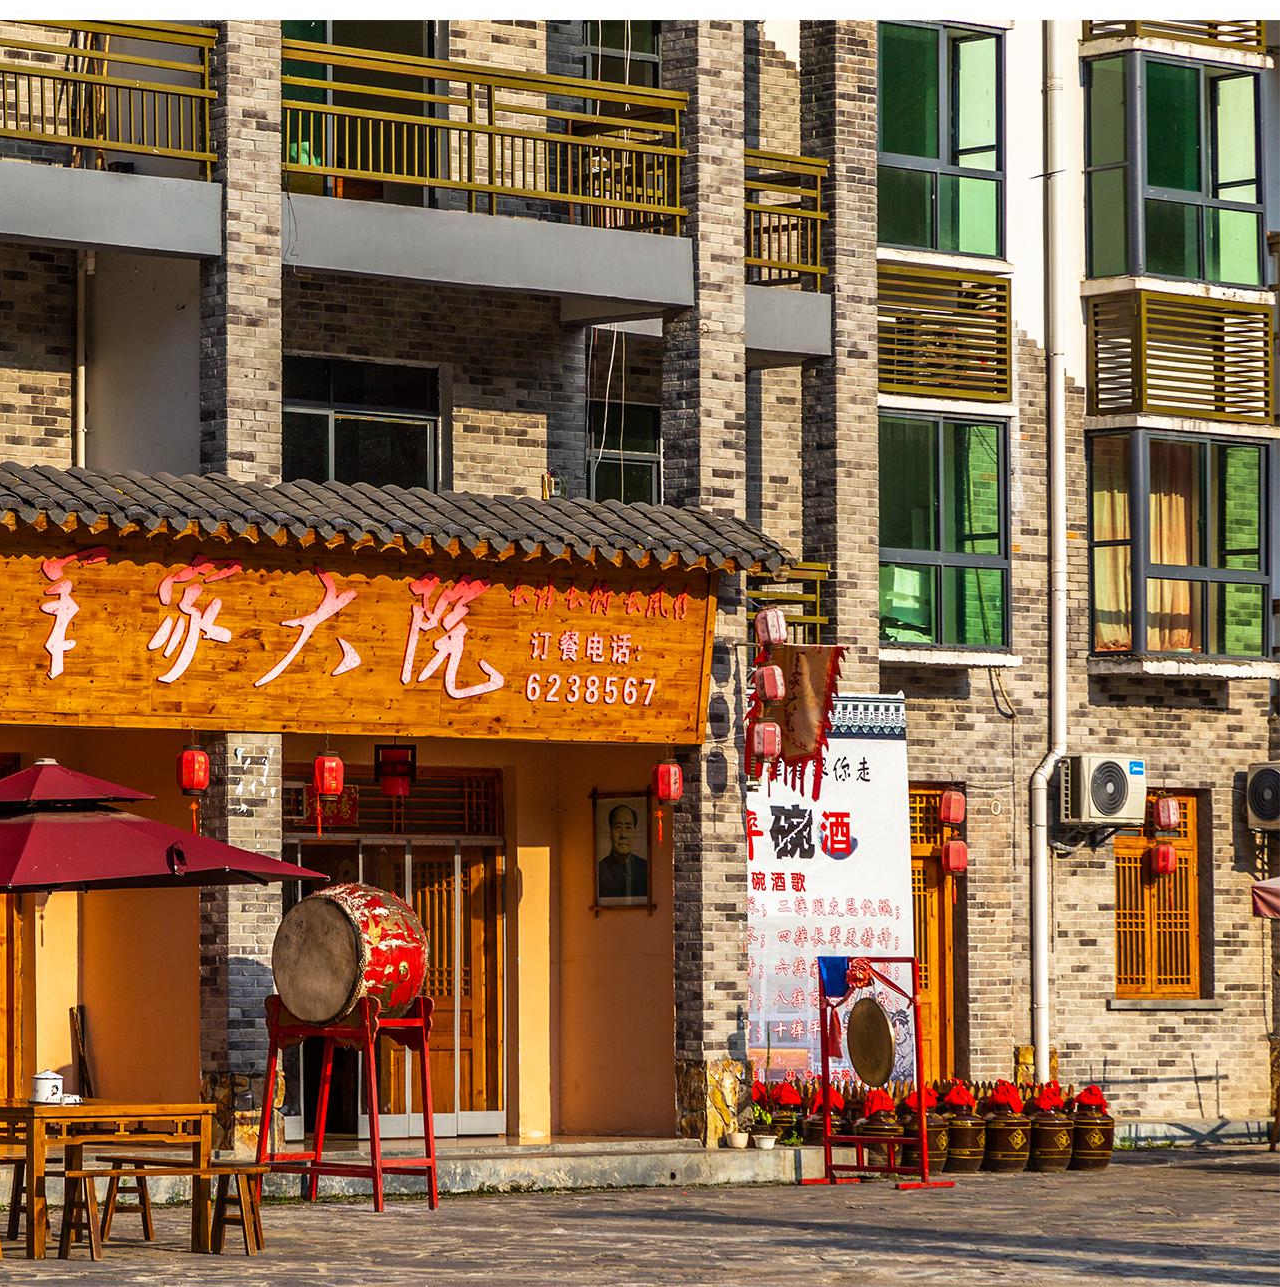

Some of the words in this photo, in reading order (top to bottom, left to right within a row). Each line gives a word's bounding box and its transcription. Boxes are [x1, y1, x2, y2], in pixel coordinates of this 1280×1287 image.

[39, 545, 504, 699] 羊家大院
[531, 630, 642, 663] 订餐电话:
[526, 673, 656, 705] 6238567
